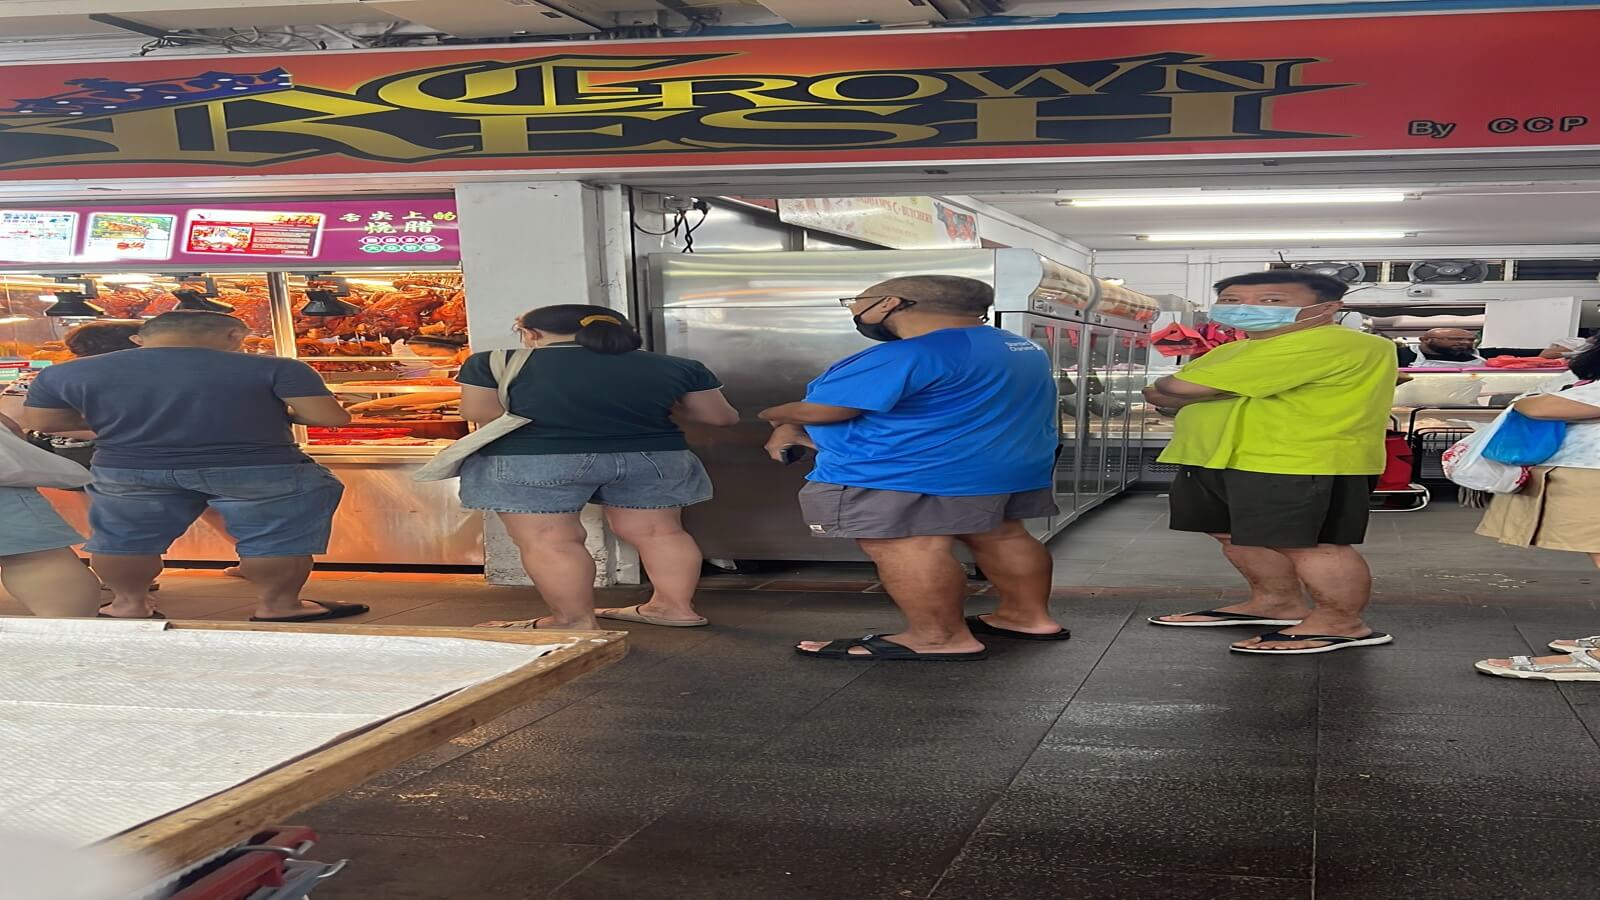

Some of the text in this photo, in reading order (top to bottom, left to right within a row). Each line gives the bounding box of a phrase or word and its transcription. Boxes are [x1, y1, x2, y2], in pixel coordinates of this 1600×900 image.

[0, 90, 1264, 163] RESH
[1409, 116, 1587, 138] By CCP
[339, 210, 457, 222] 舌尖上的
